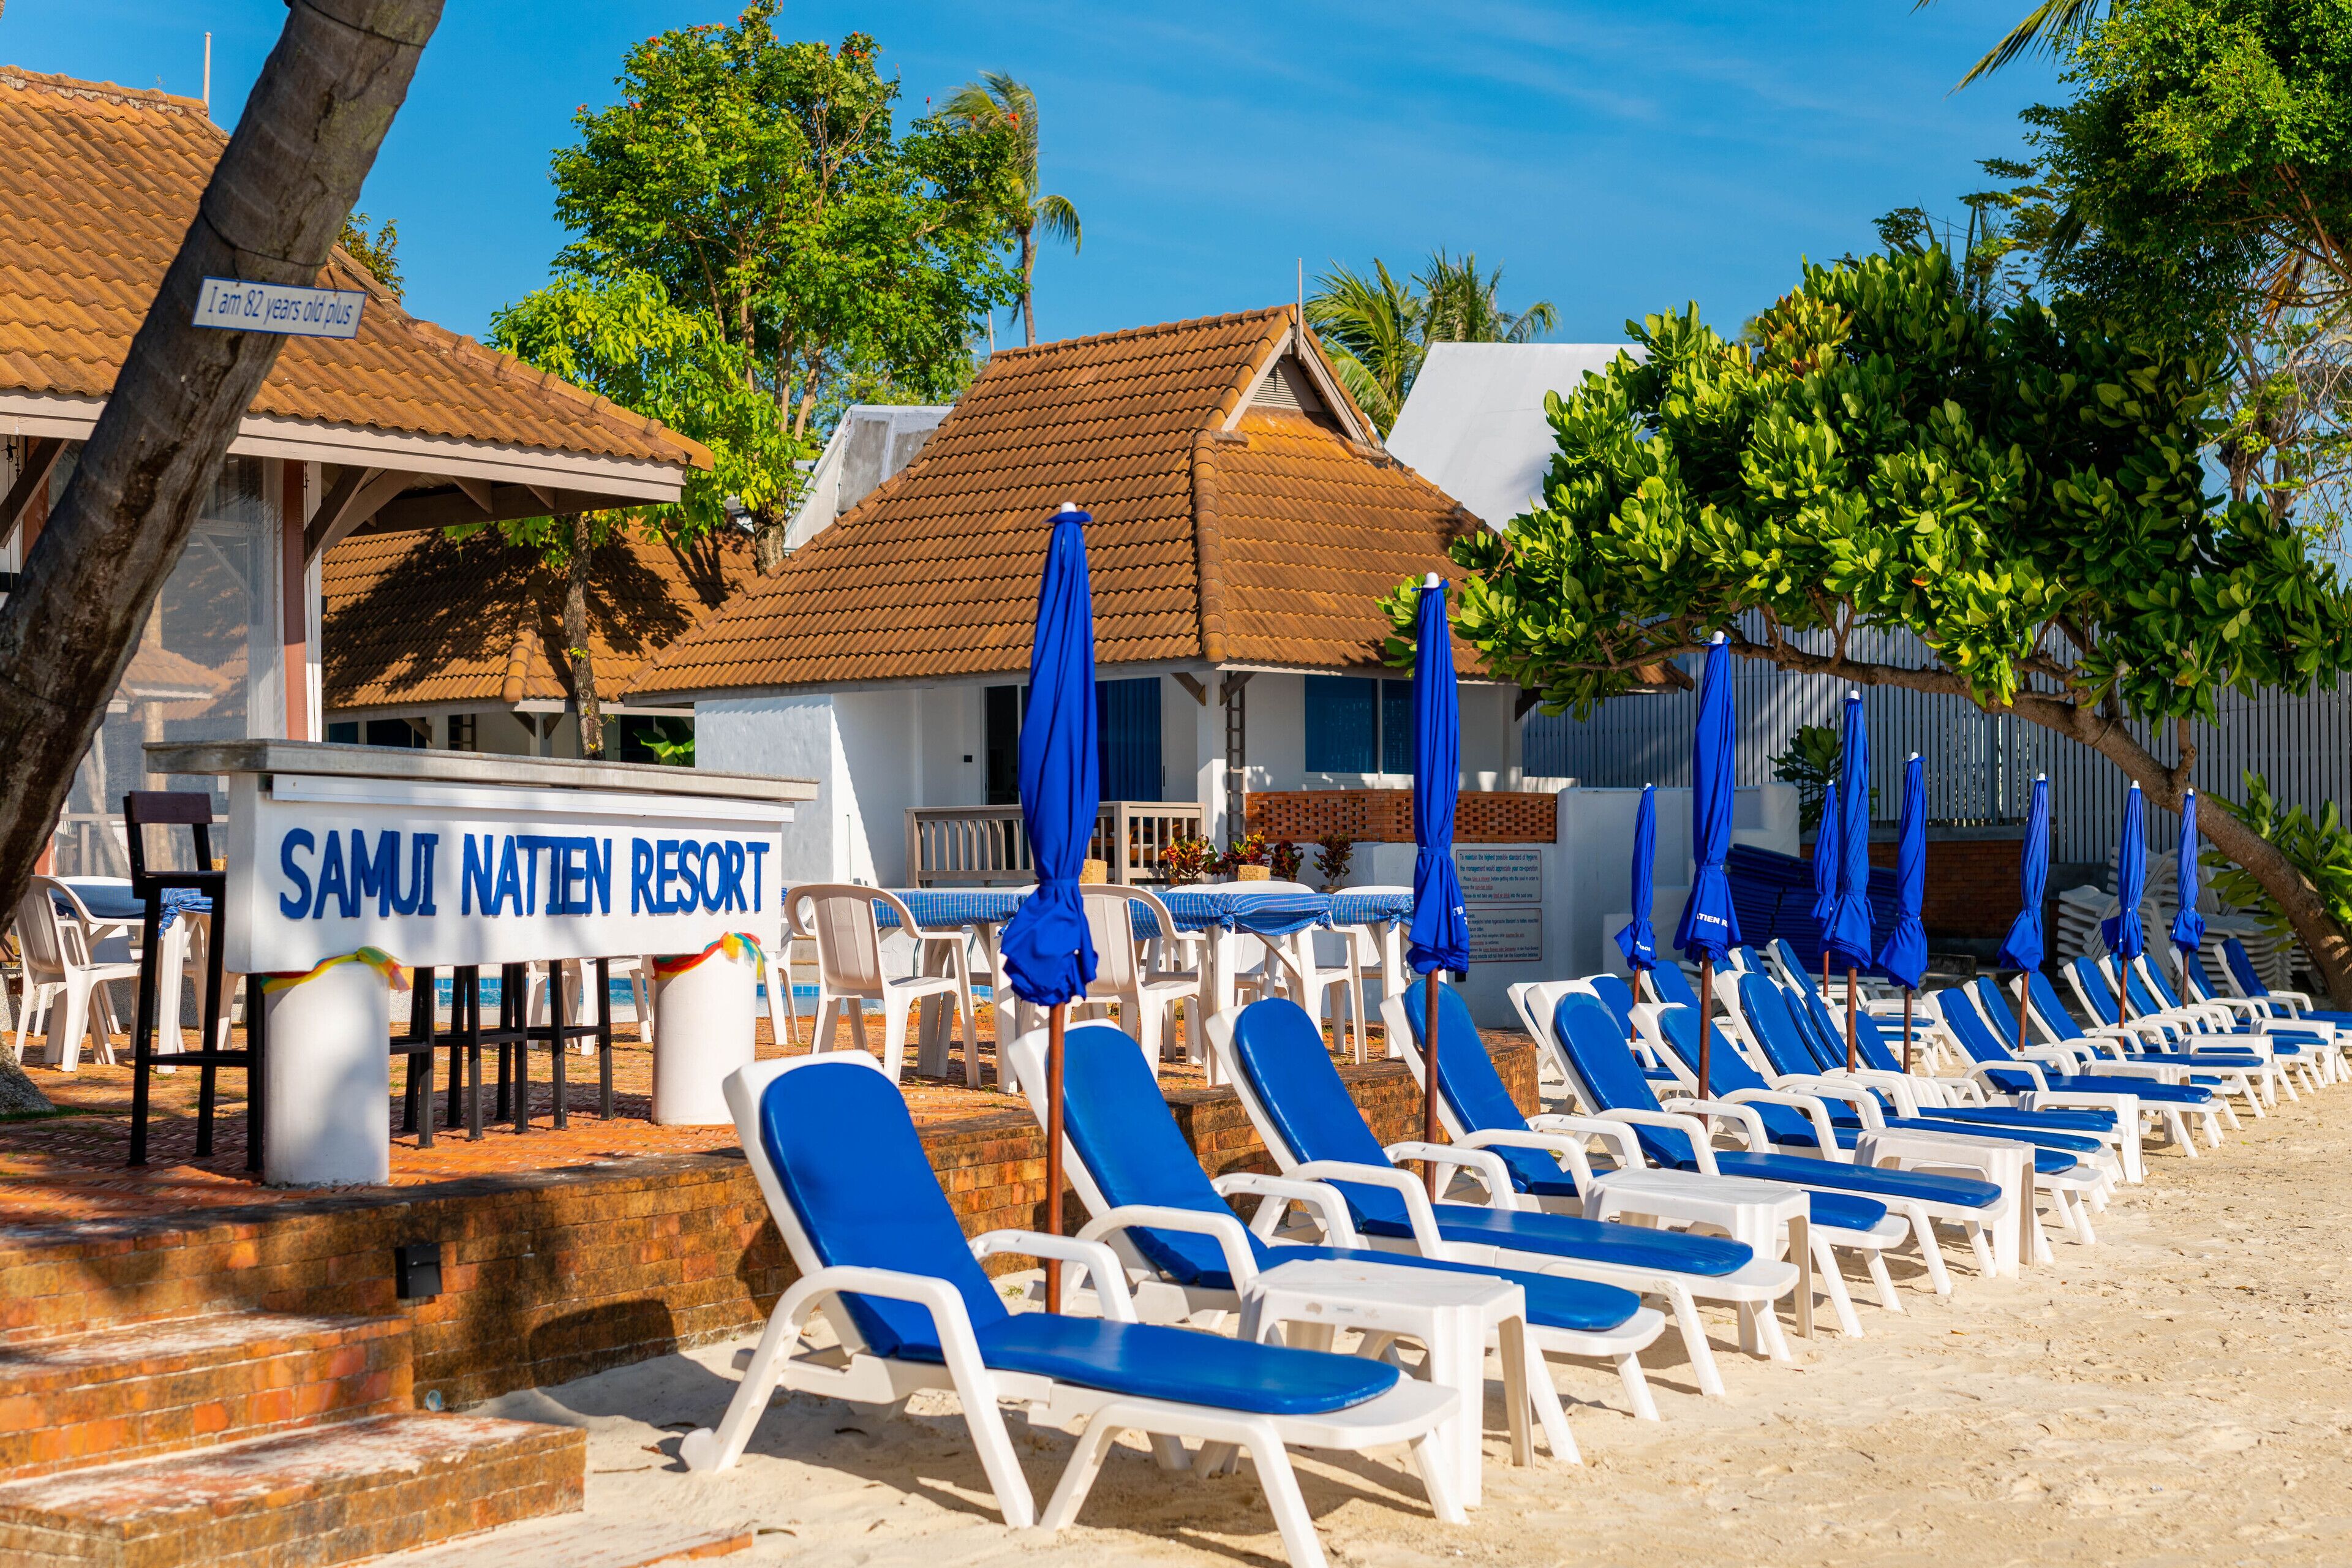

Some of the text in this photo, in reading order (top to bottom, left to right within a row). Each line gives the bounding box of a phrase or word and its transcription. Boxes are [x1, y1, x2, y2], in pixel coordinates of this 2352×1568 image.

[208, 286, 353, 330] I am 82 years old plus
[279, 827, 769, 919] SAMUI NATIEN RESORT
